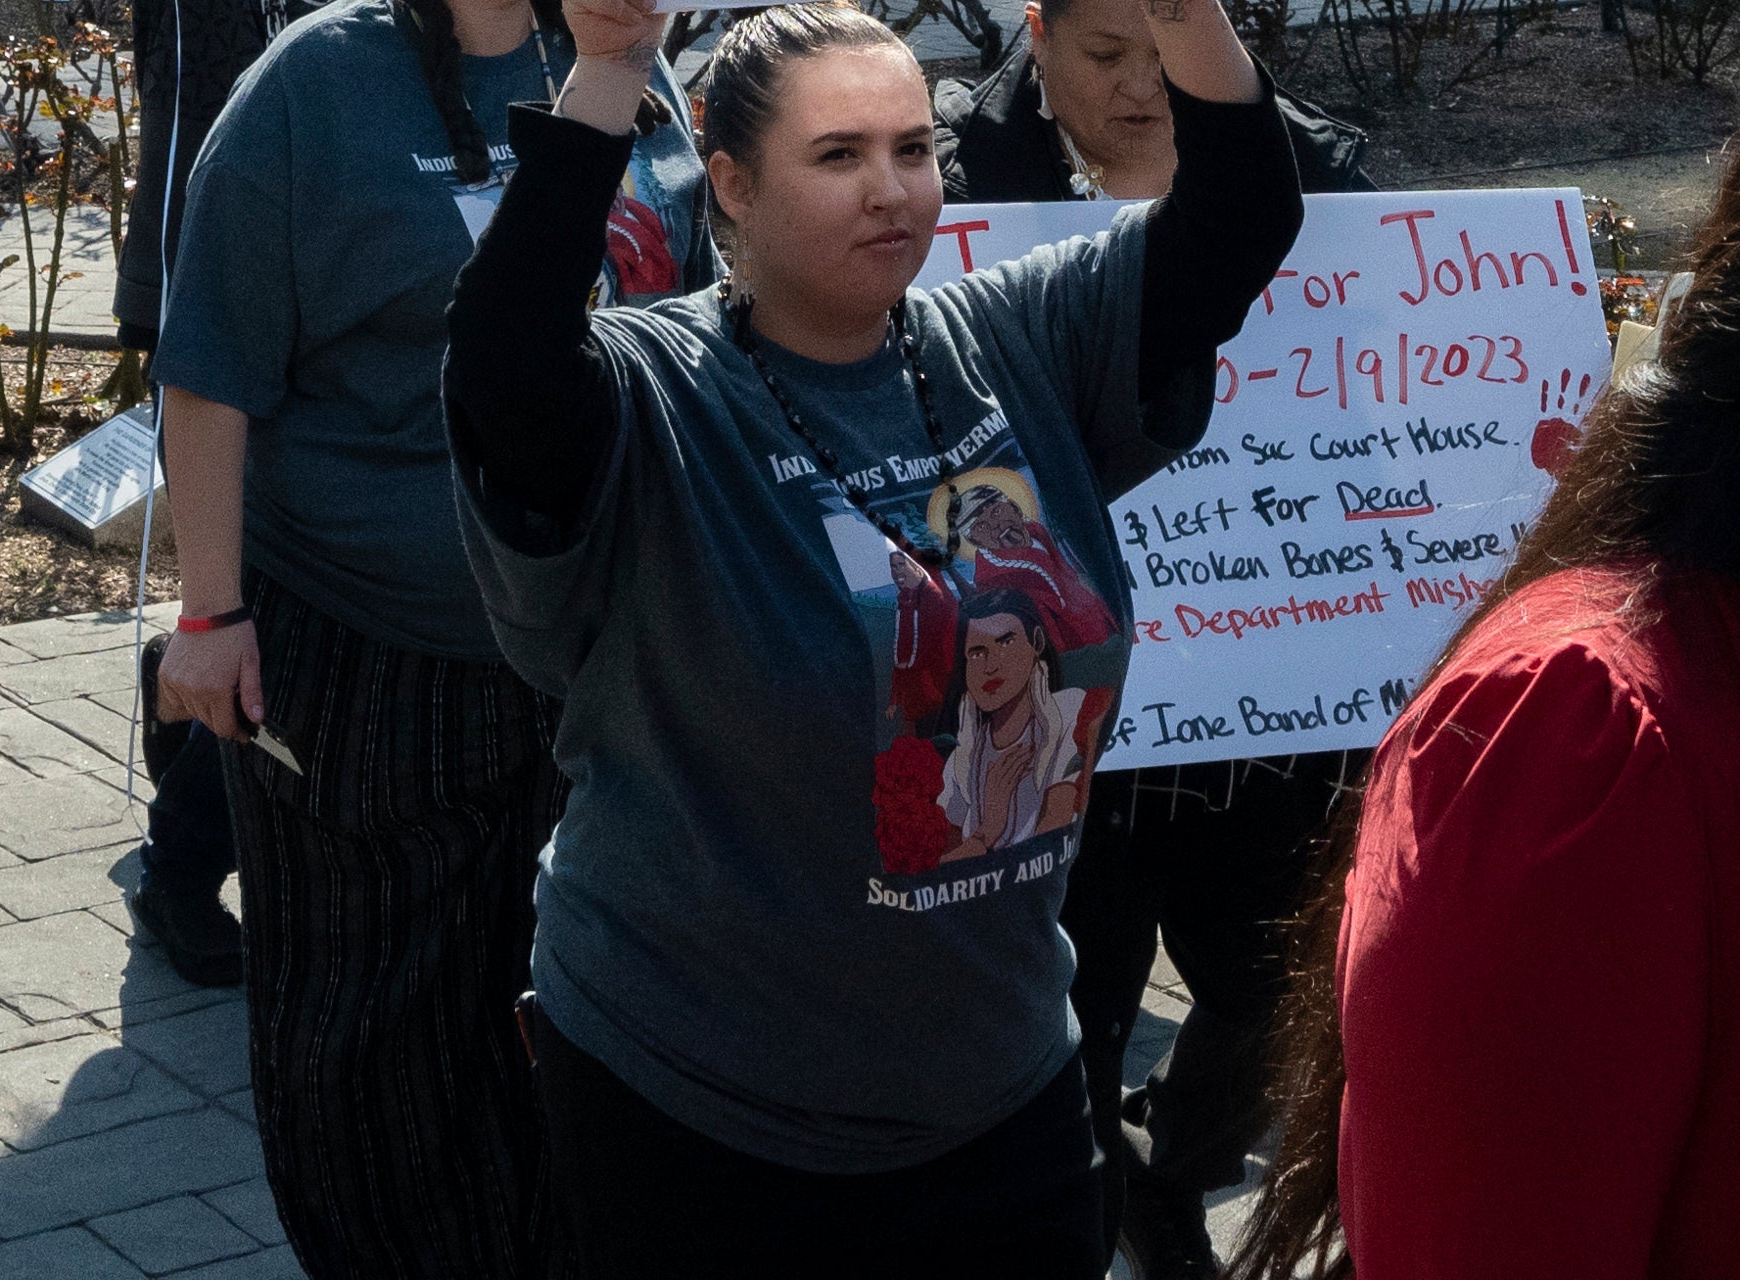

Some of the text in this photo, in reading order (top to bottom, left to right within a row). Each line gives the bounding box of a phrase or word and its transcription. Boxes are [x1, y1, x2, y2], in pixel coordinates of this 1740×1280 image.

[1380, 199, 1587, 306] John!
[1167, 447, 1231, 475] rom
[1241, 433, 1295, 466] Sac
[1310, 426, 1400, 461] Court
[1152, 497, 1239, 543] Left
[1251, 485, 1320, 528] For
[1145, 551, 1270, 588] Broken
[1280, 540, 1374, 580] Bones
[1406, 529, 1506, 564] Severe
[1134, 620, 1171, 644] re
[1174, 581, 1391, 640] Department
[1238, 694, 1328, 736] Band
[1333, 688, 1374, 726] of
